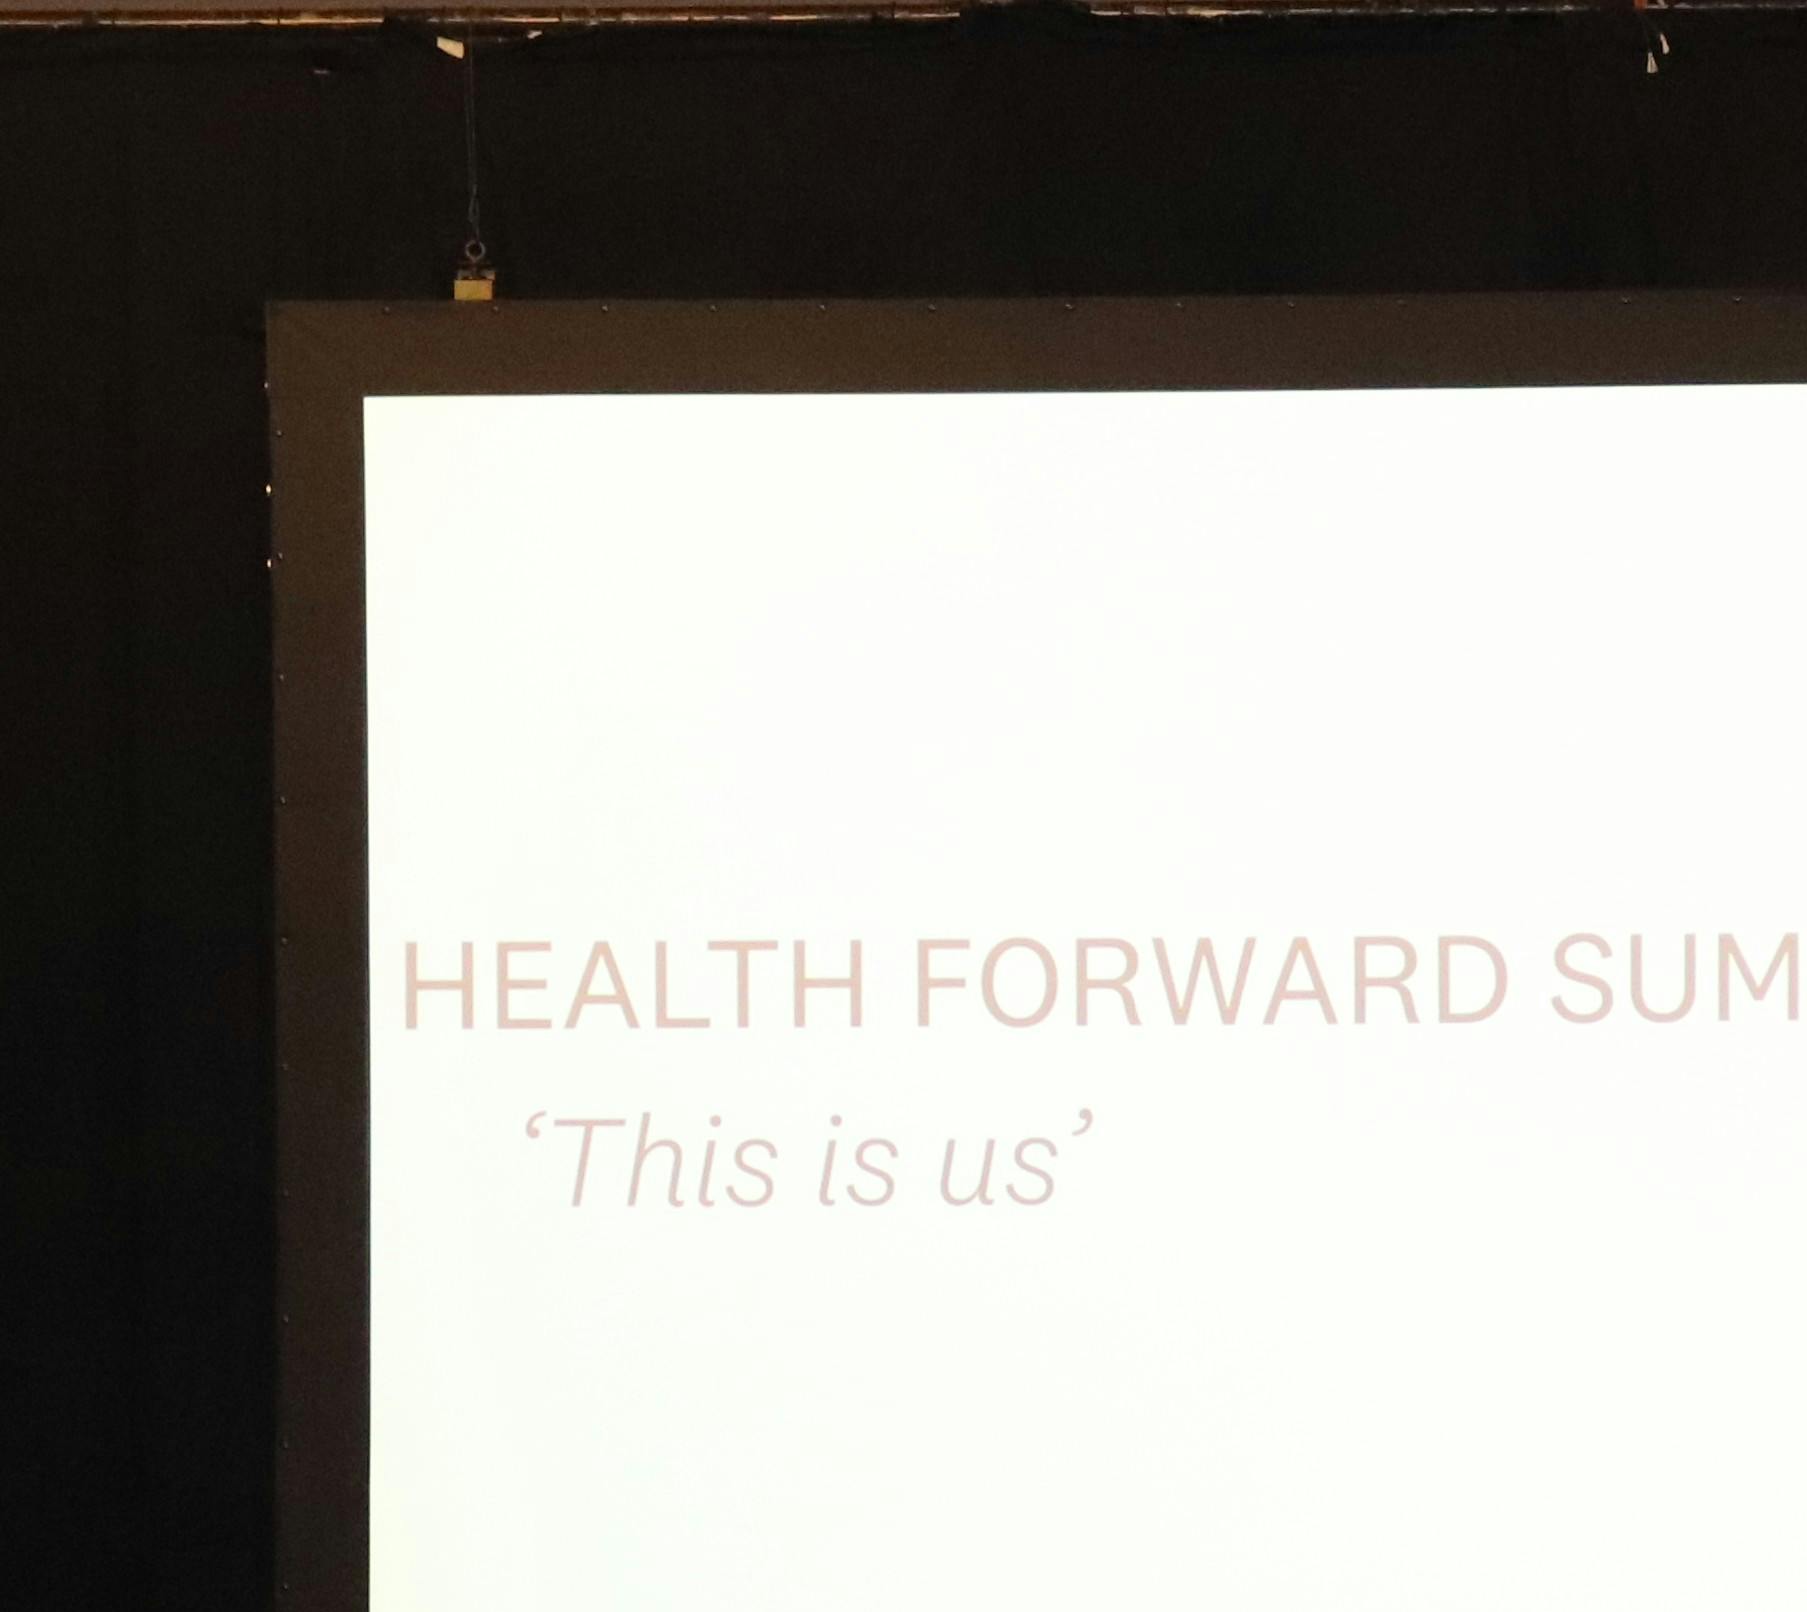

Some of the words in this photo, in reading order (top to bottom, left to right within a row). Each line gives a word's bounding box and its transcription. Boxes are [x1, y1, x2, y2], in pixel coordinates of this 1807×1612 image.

[405, 939, 864, 1030] HEALTH
[917, 936, 1510, 1029] FORWARD
[819, 1115, 900, 1208] is
